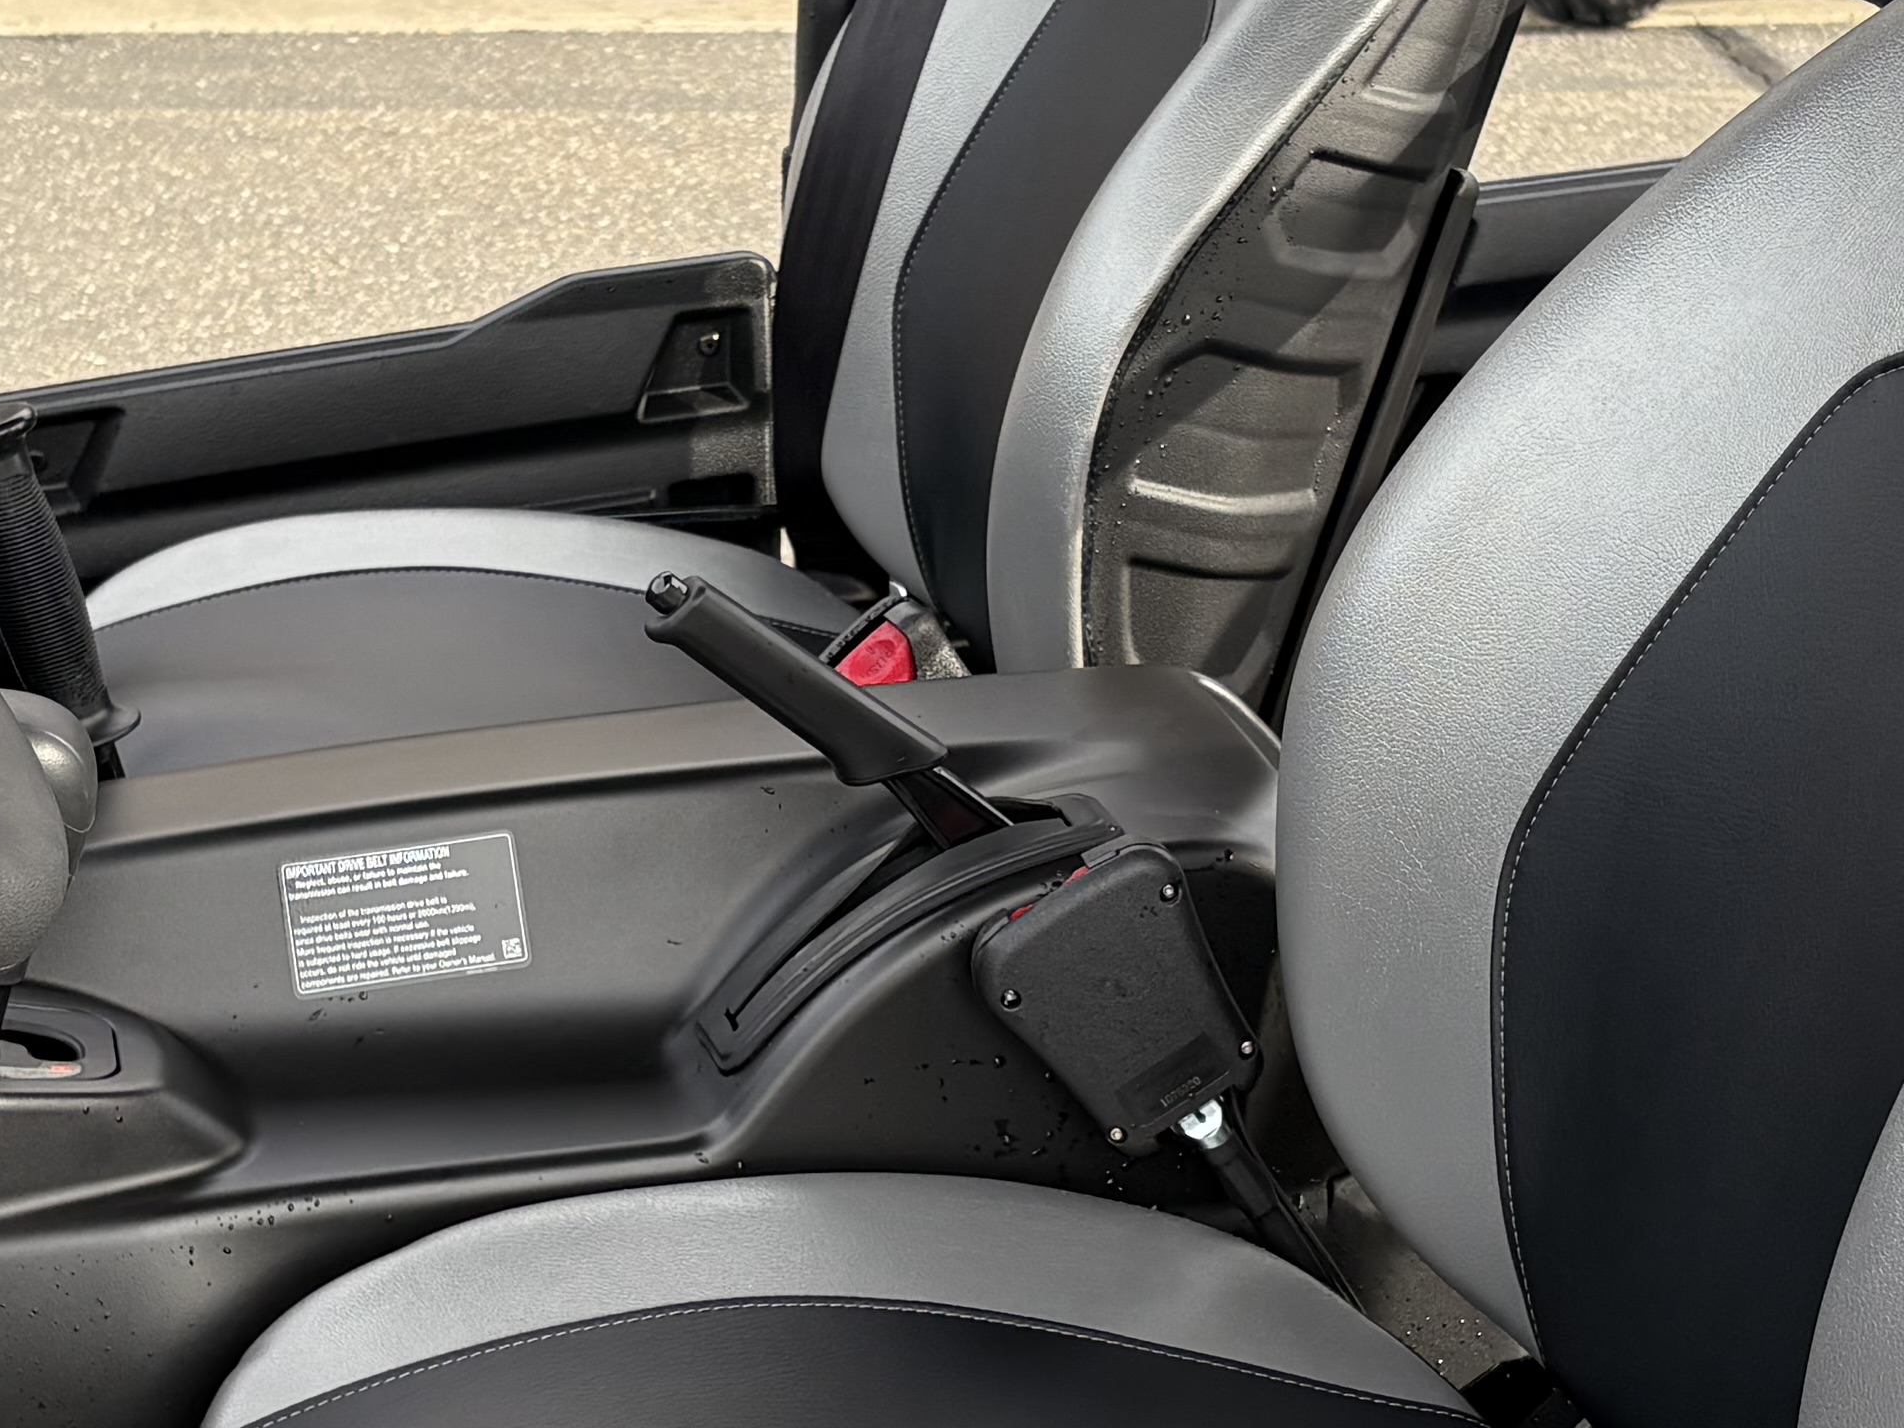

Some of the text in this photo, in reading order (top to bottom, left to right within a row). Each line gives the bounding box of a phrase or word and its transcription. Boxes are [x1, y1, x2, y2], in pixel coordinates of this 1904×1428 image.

[286, 846, 450, 880] IMPORTANT DRIVE BELT INFORMATION
